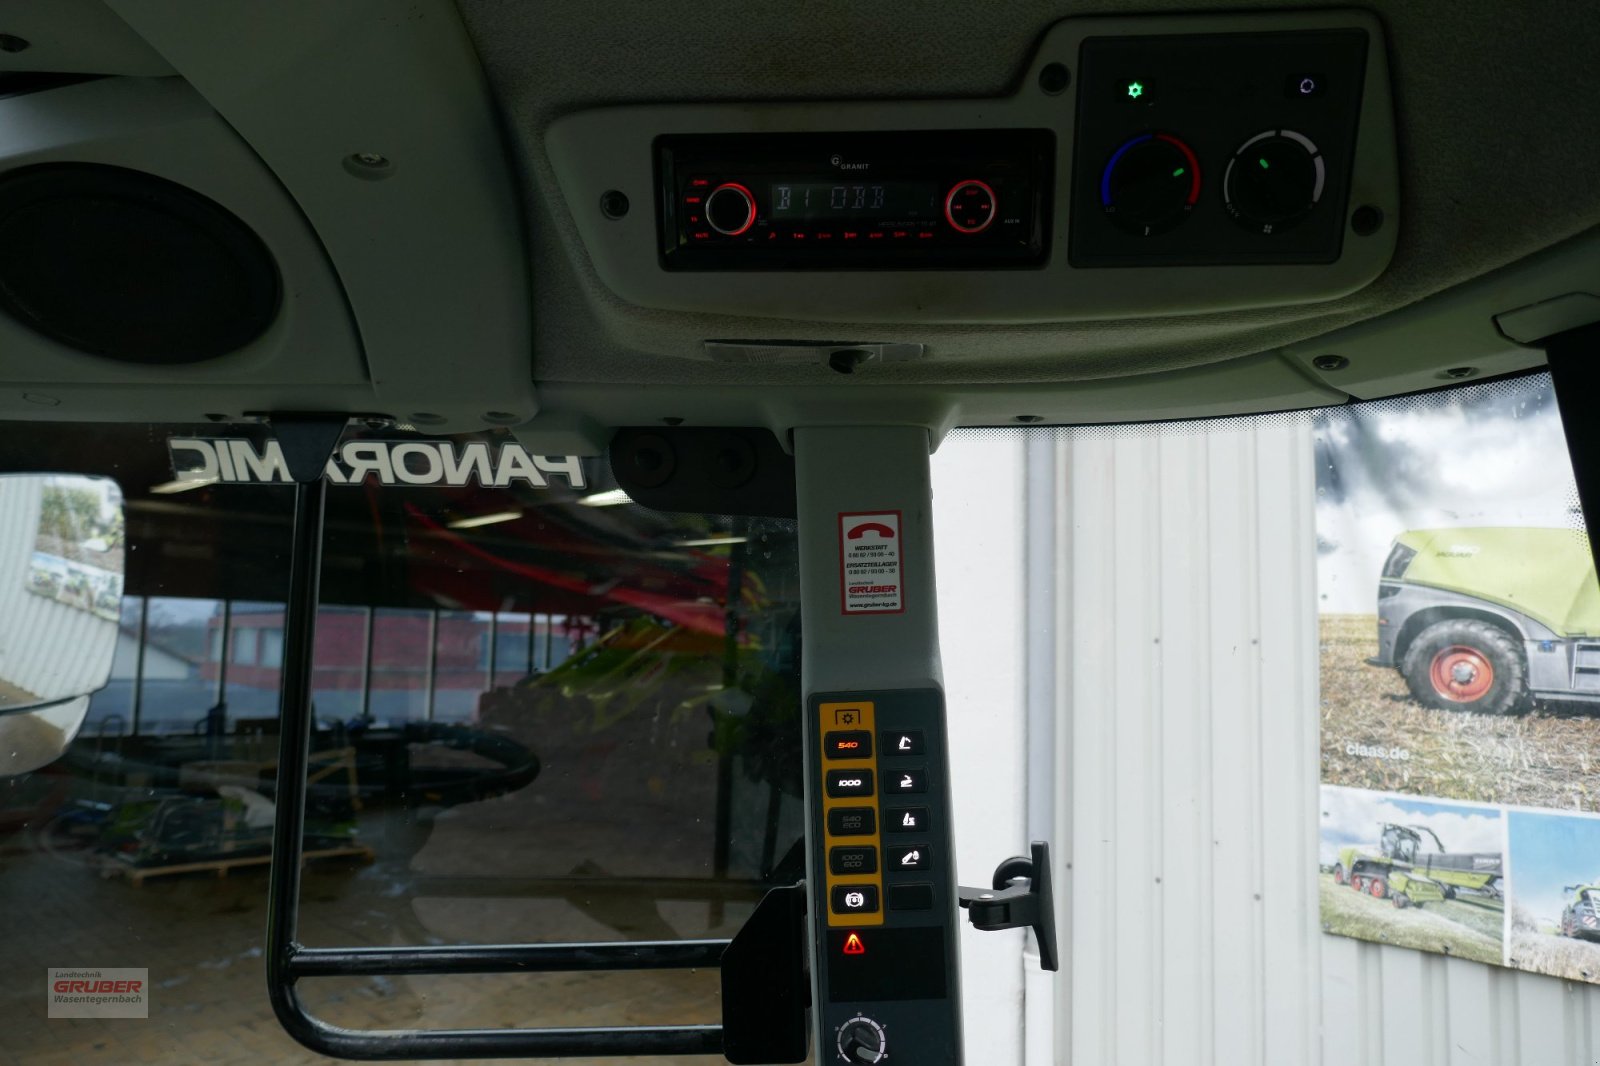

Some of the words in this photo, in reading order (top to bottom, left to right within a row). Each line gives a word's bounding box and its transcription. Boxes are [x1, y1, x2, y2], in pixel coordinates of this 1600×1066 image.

[849, 585, 897, 593] GRUBER
[837, 741, 858, 749] 540
[1345, 742, 1410, 760] claas.de
[838, 779, 861, 787] 1000
[842, 815, 861, 823] 540
[843, 821, 861, 829] ECO
[841, 854, 864, 862] 1000
[843, 860, 862, 868] ECO
